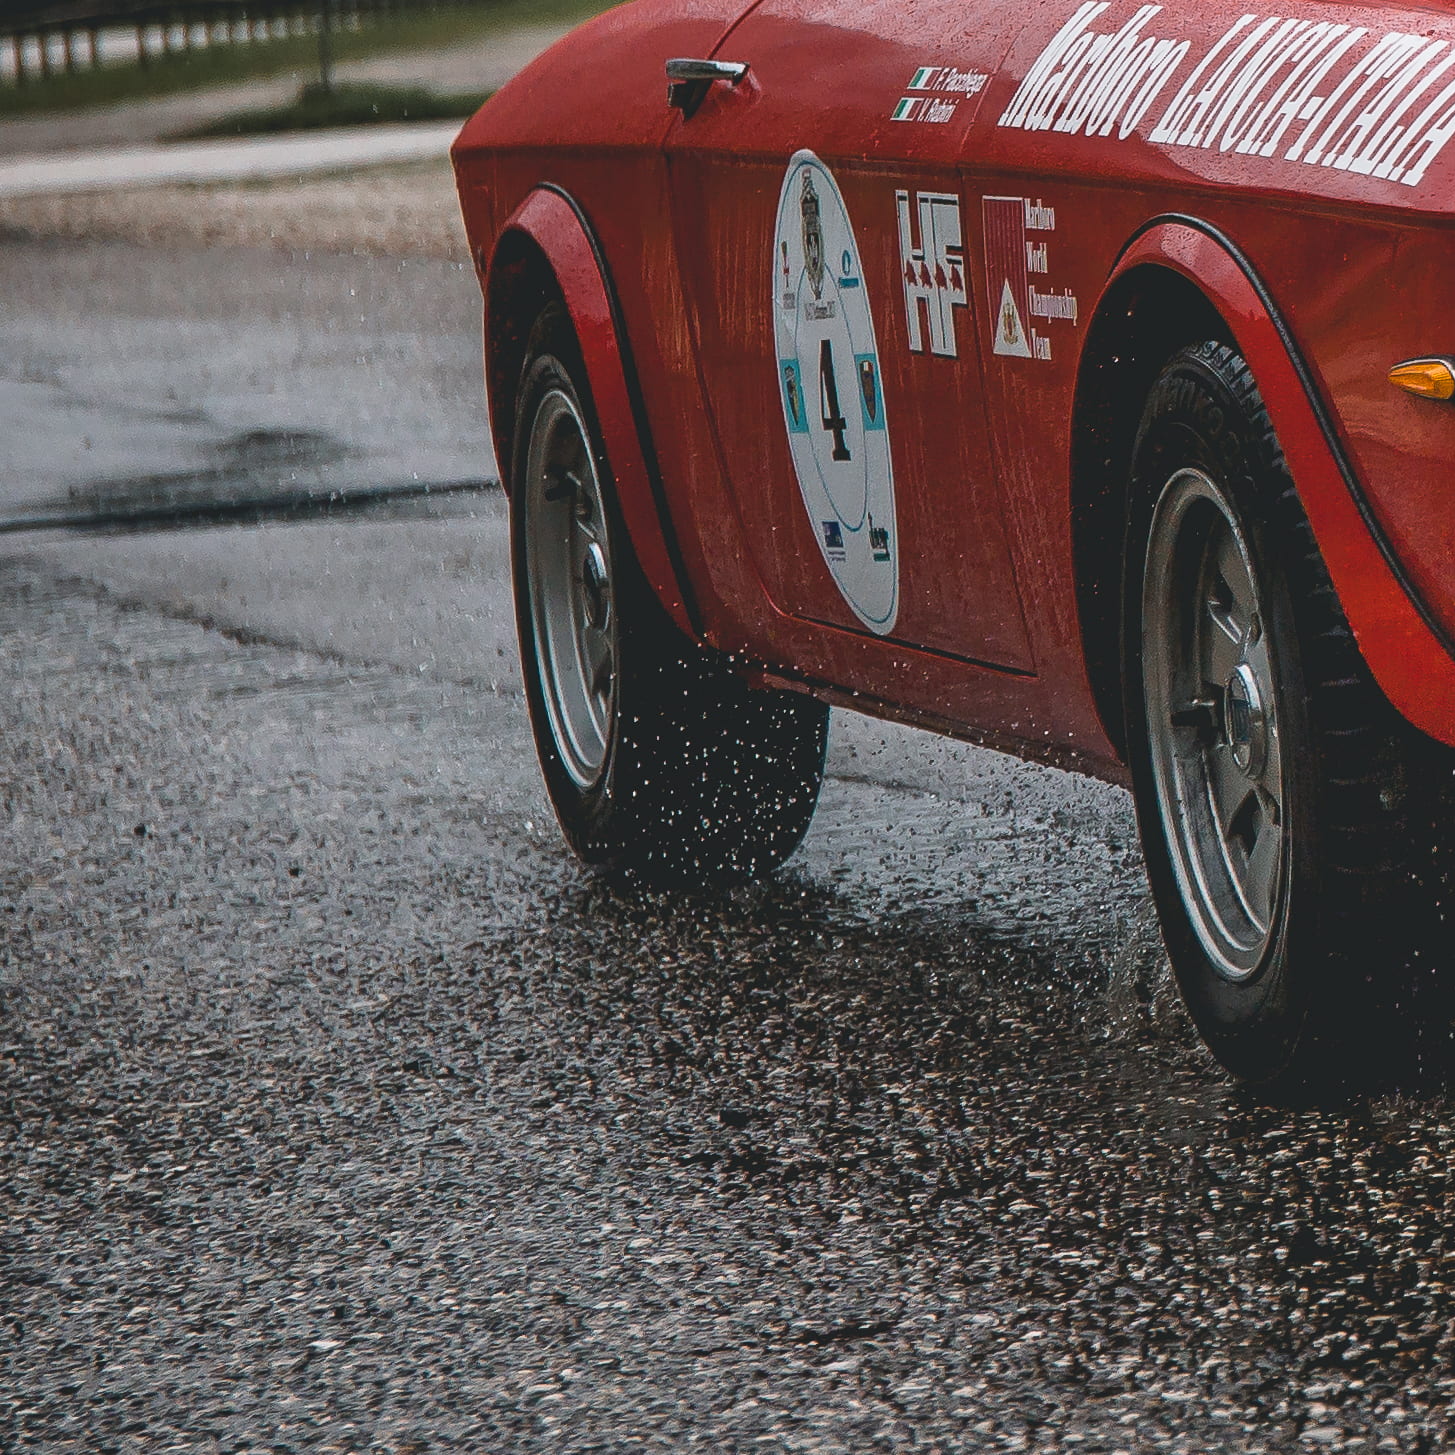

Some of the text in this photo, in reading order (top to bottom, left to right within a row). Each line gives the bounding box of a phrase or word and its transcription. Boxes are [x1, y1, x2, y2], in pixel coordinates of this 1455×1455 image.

[997, 0, 1193, 140] Marlboro
[1024, 198, 1056, 231] Marlboro
[895, 189, 967, 358] HF
[1025, 241, 1048, 274] World
[1028, 284, 1078, 327] Championship
[1030, 327, 1052, 360] Team
[819, 338, 852, 462] 4
